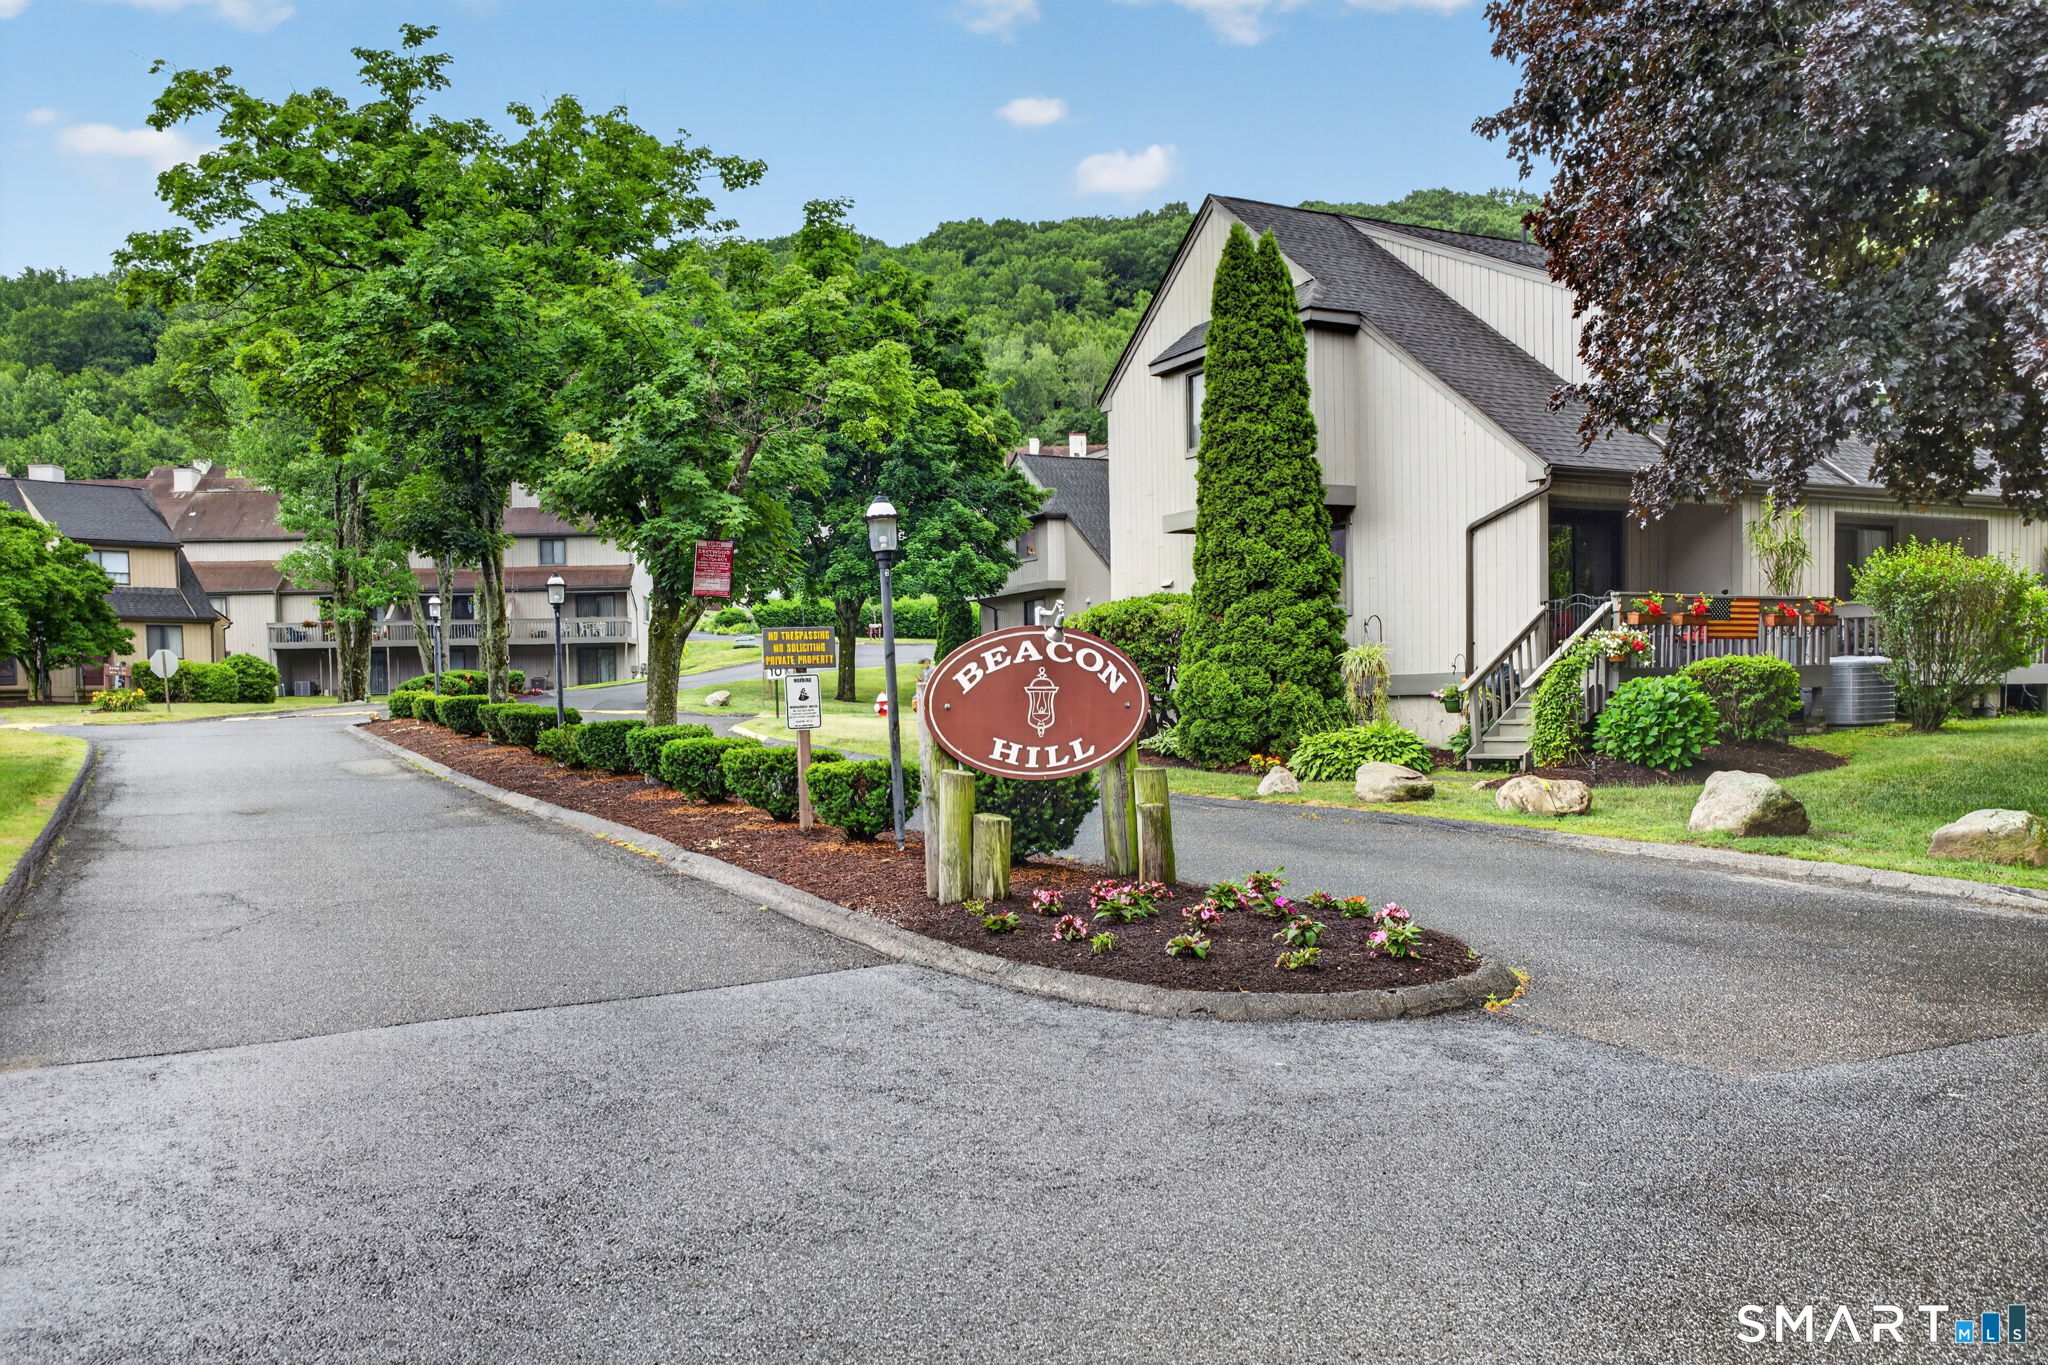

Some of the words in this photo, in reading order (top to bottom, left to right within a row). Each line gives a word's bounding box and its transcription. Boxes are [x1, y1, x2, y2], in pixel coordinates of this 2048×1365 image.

[768, 631, 778, 641] NO
[781, 630, 830, 640] TRESPASSING
[773, 643, 784, 653] NO
[786, 642, 826, 653] SOLICITING
[765, 655, 795, 665] PRIVATE
[798, 654, 834, 665] PROPERTY
[952, 640, 1128, 695] BEACON
[988, 737, 1095, 768] HILL
